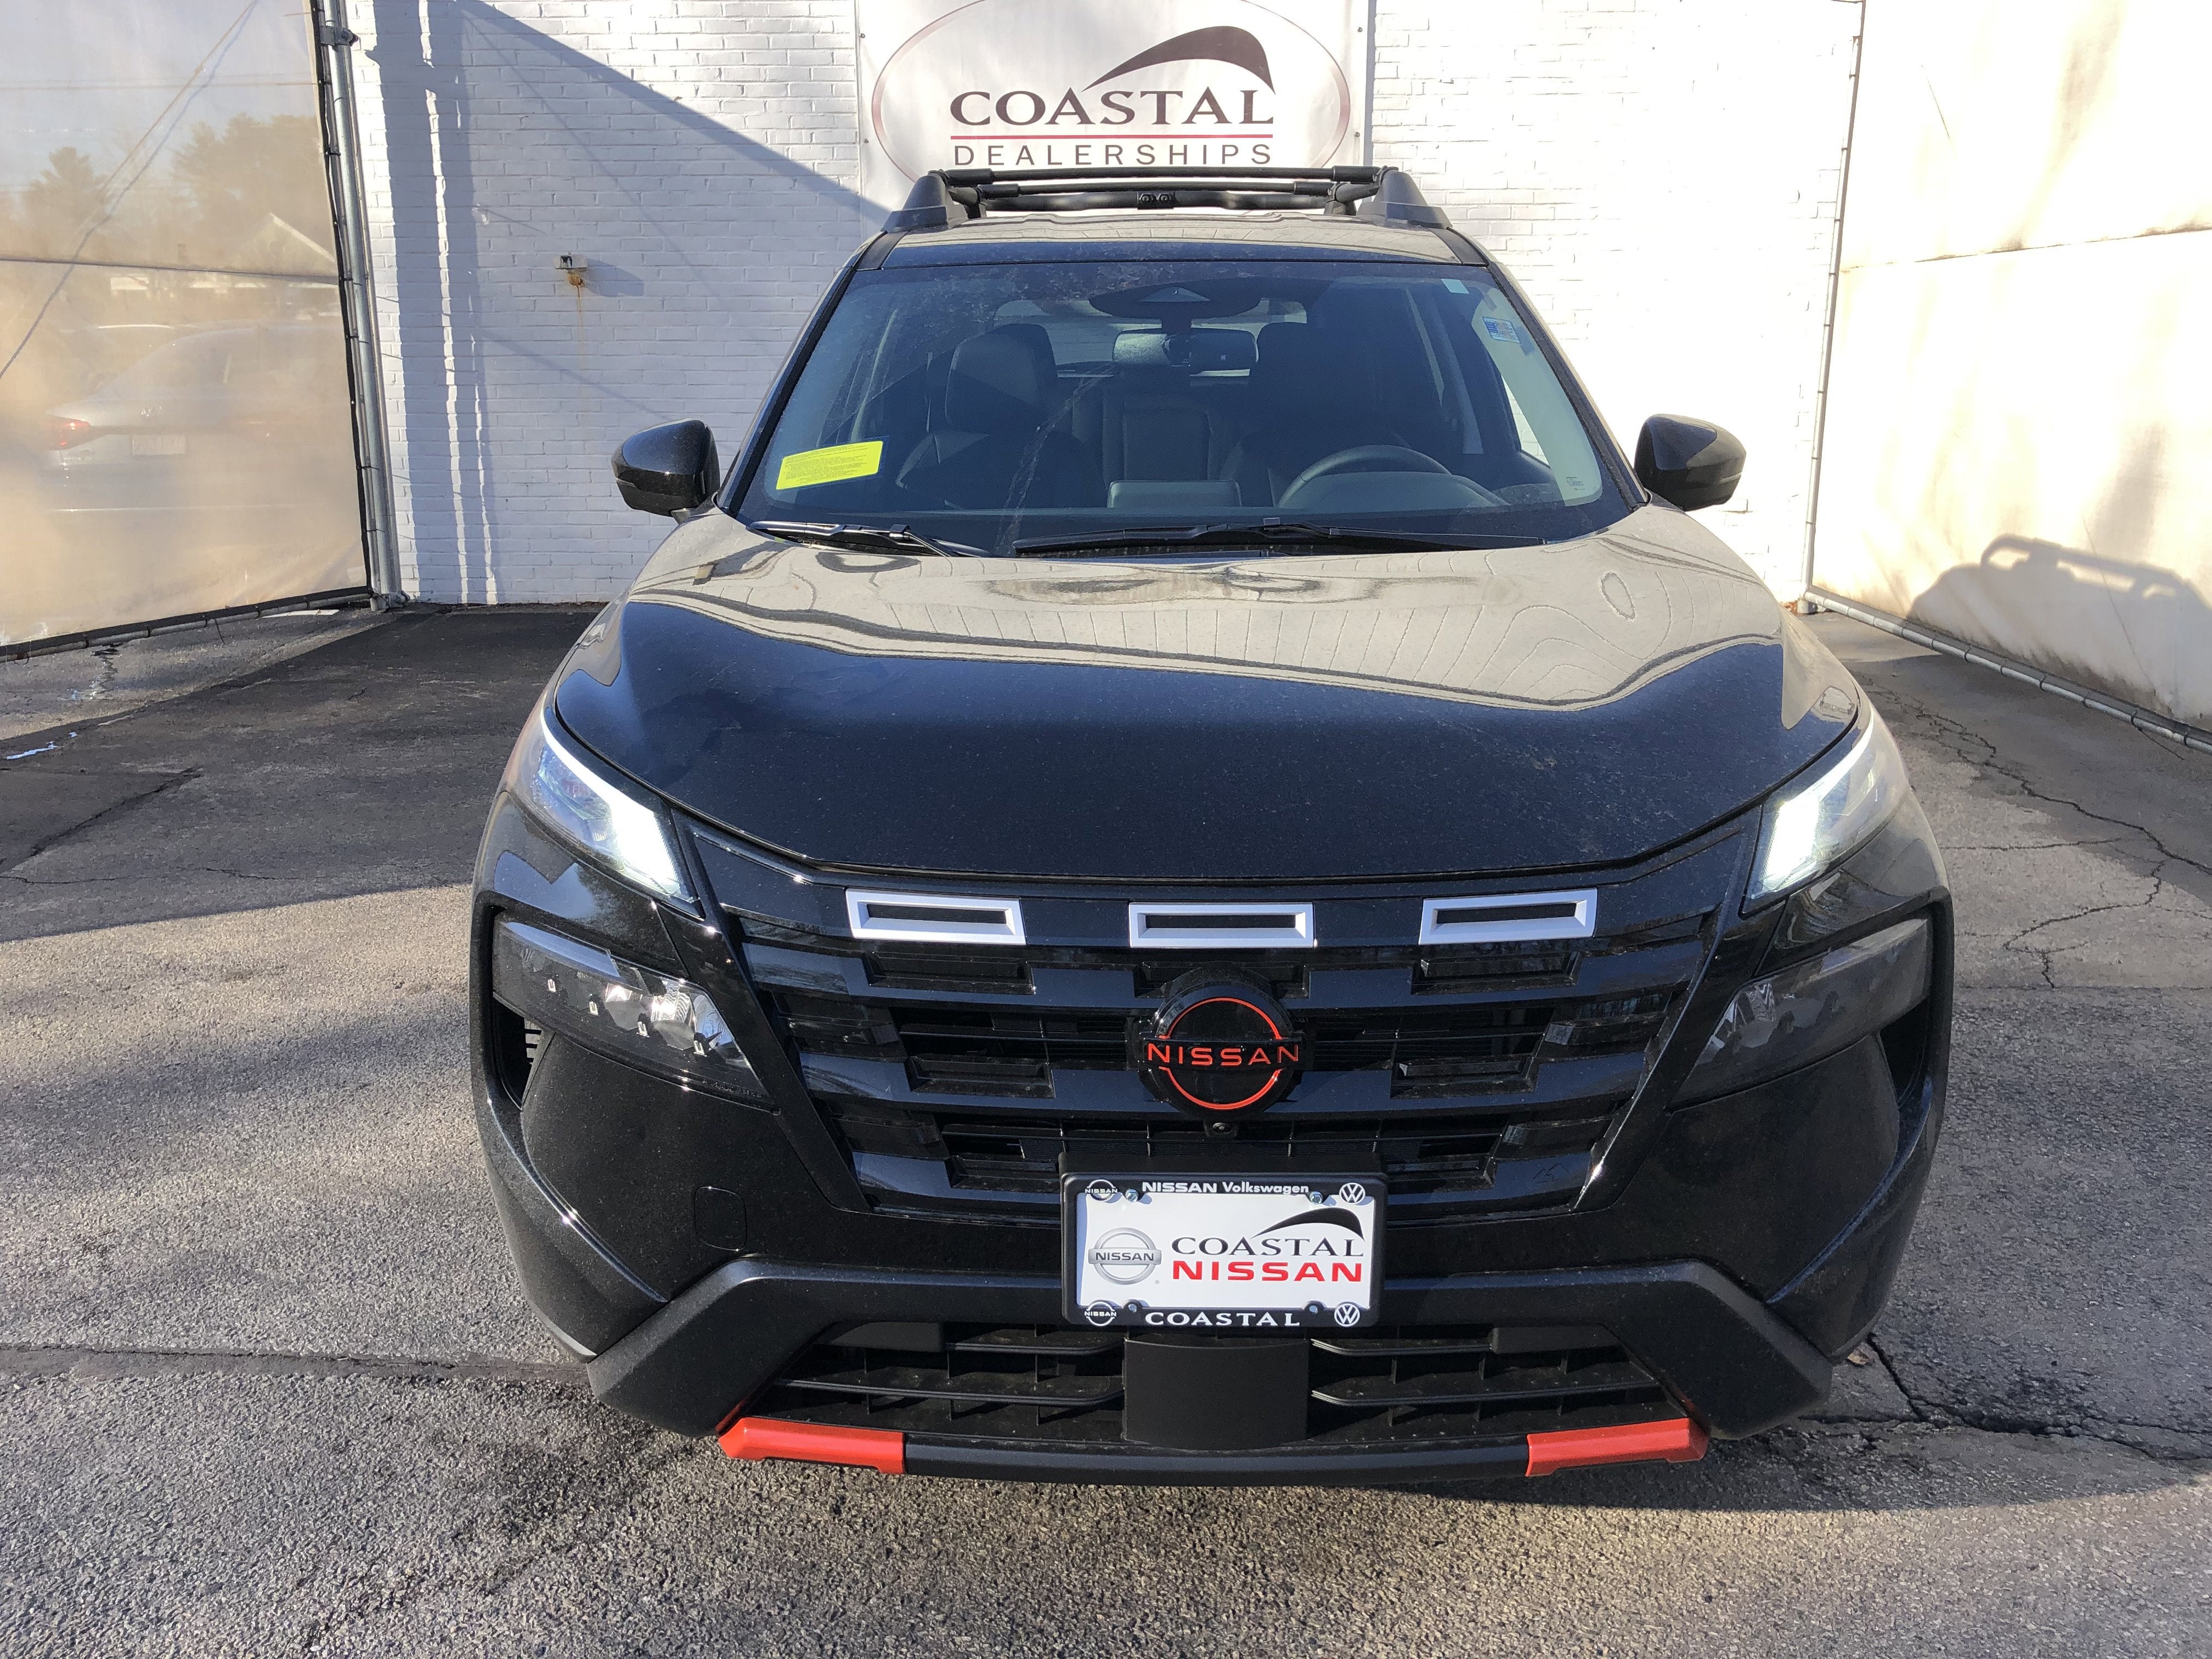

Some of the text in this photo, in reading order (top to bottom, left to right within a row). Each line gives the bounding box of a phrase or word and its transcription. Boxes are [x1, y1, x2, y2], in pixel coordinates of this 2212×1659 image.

[950, 87, 1273, 125] COASTAL
[955, 144, 1271, 166] DEALERSHIPS
[1147, 1042, 1299, 1066] NISSAN
[1142, 1182, 1217, 1193] NISSAN
[1222, 1181, 1309, 1195] Volkswagen
[1096, 1252, 1154, 1261] NISSAN
[1171, 1236, 1364, 1257] COASTAL
[1172, 1260, 1362, 1282] NISSAN
[1145, 1311, 1300, 1327] COASTAL
